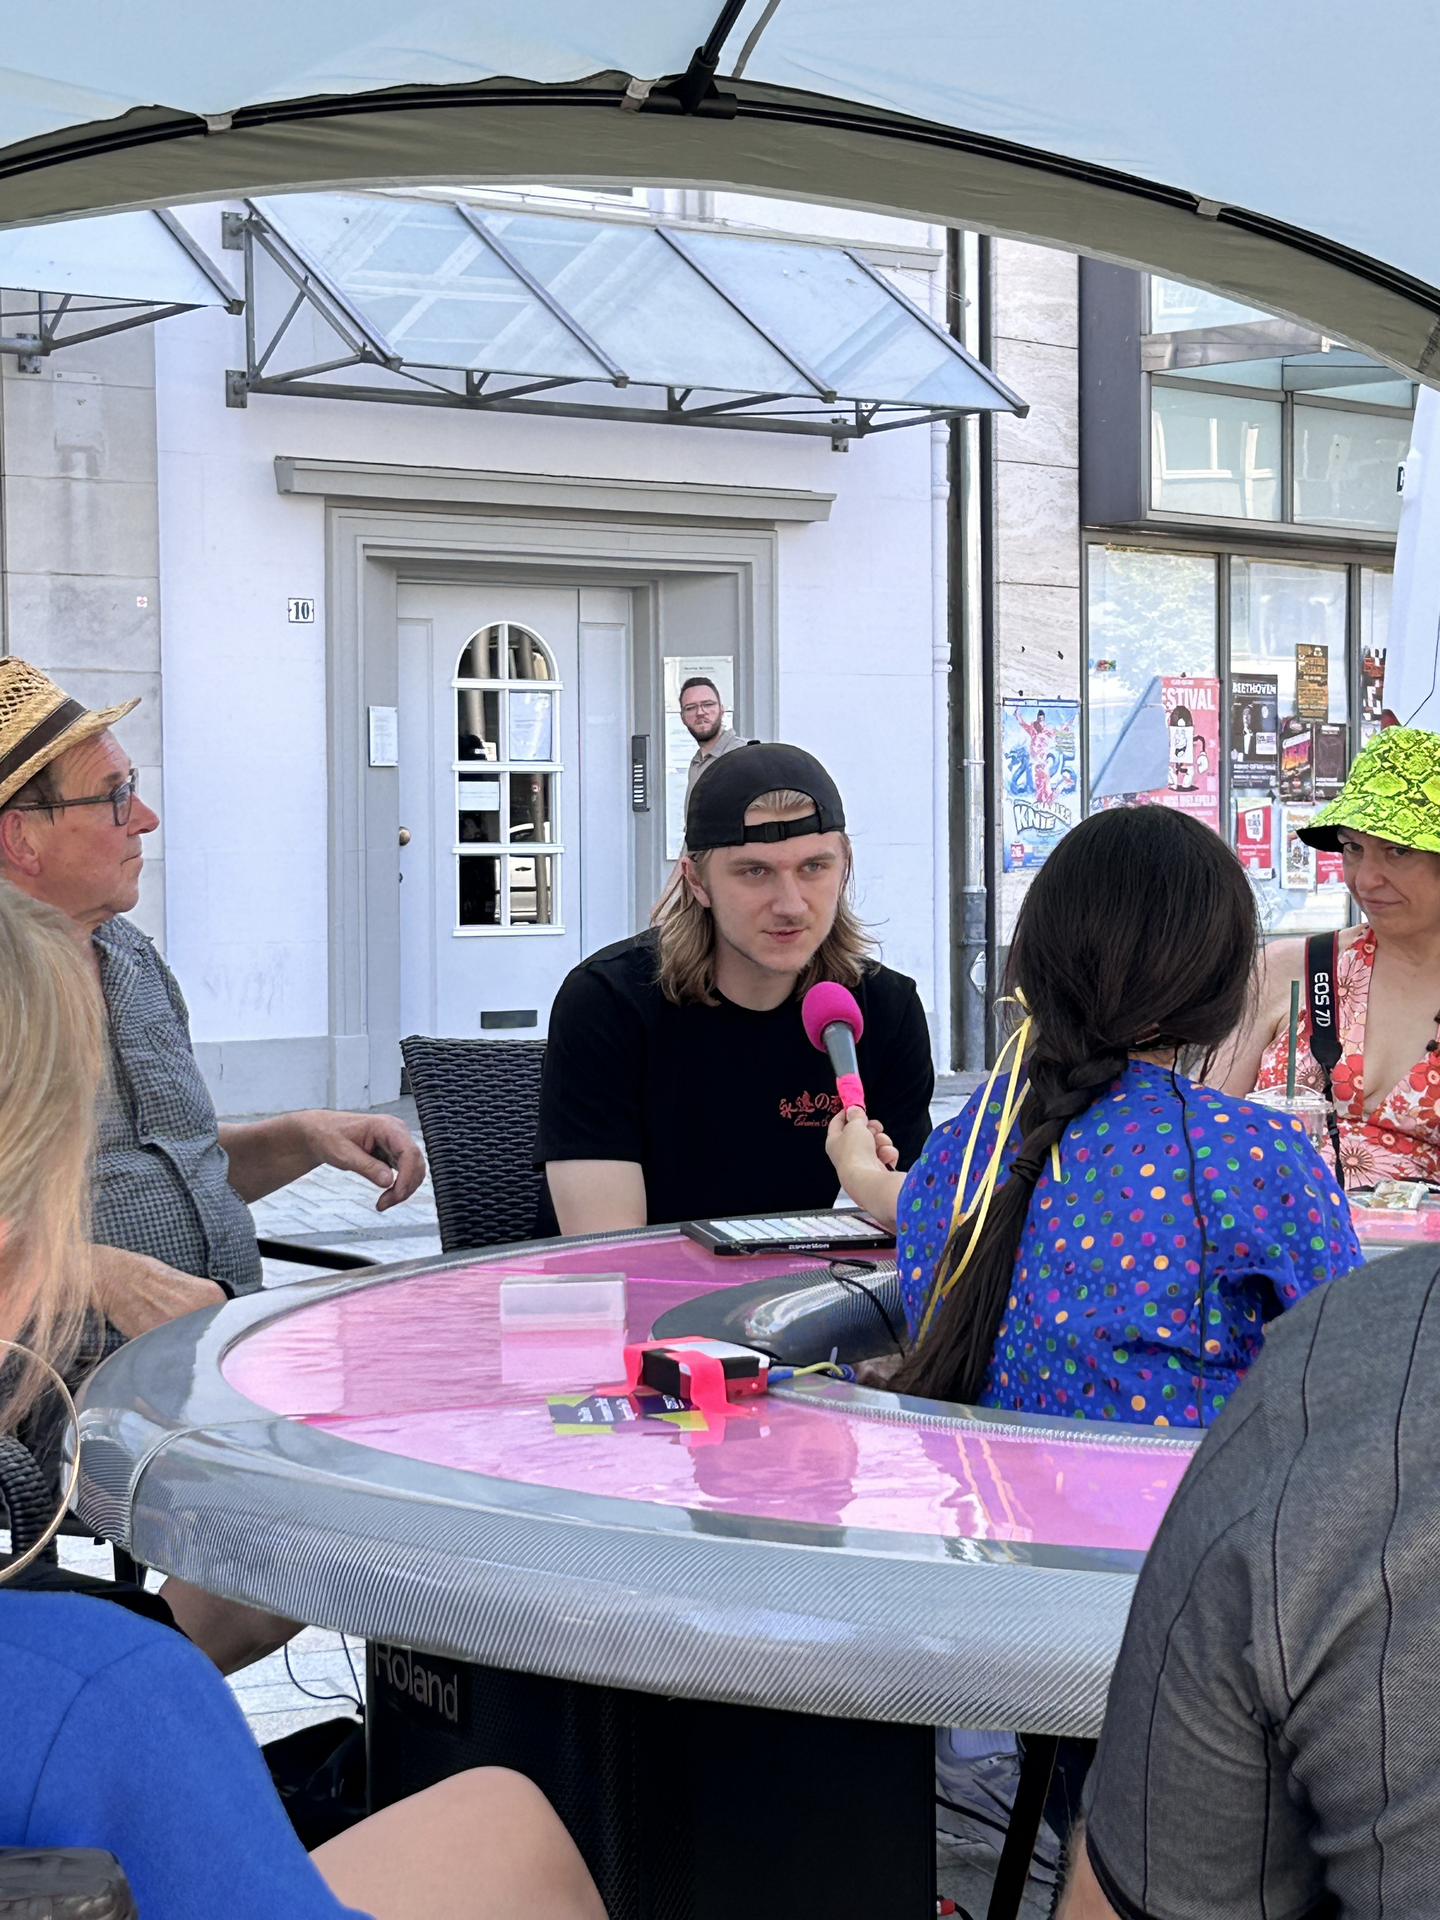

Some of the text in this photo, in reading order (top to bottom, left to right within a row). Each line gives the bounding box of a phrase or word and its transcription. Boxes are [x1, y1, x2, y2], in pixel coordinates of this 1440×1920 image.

[293, 601, 310, 620] 10
[1015, 806, 1056, 832] KNIE
[1314, 972, 1331, 1027] EOS 7D
[375, 1642, 458, 1724] Roland
